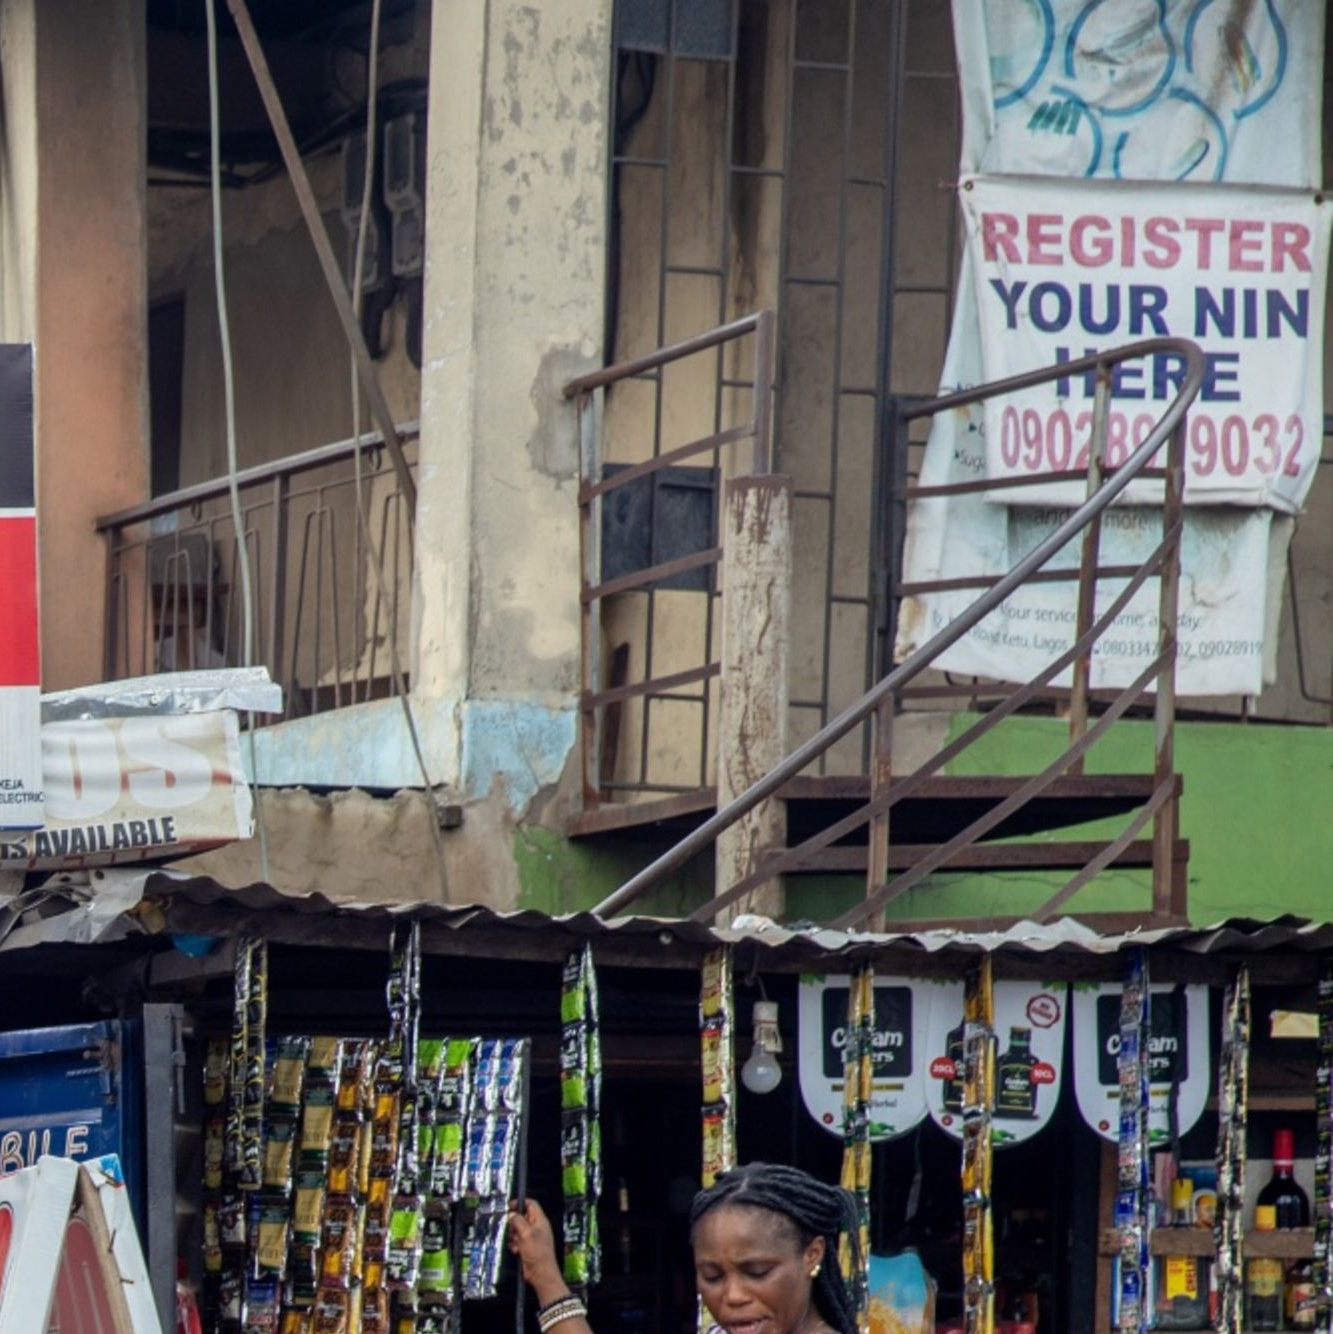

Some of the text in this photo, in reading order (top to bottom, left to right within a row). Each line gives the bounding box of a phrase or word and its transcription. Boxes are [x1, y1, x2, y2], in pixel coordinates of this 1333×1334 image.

[981, 212, 1312, 273] REGISTER
[990, 279, 1309, 339] YOUR NIN
[1056, 347, 1241, 402] HERE
[1000, 404, 1304, 477] 0902899032
[35, 816, 177, 858] AVAILABLE
